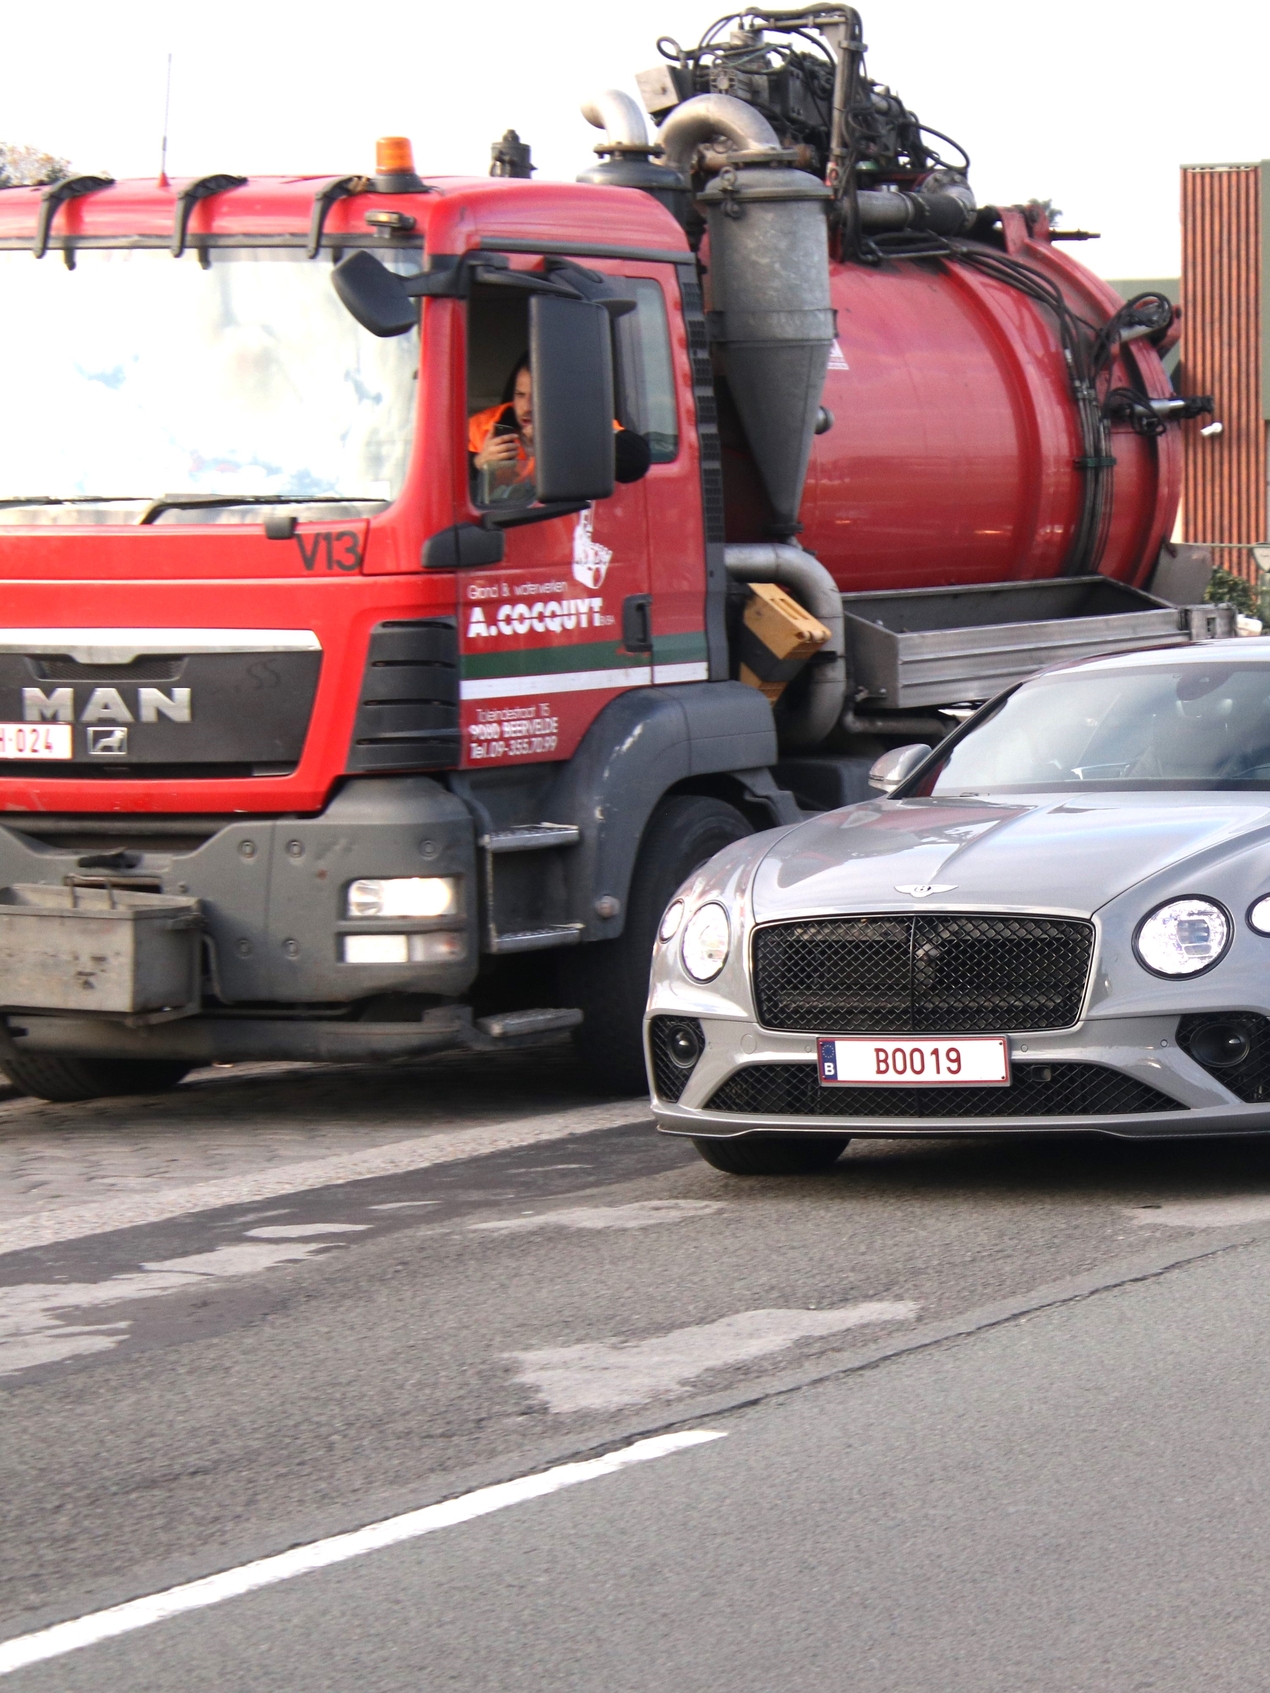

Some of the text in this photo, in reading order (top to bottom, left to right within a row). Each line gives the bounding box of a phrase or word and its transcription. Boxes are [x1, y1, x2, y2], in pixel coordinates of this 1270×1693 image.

[295, 530, 362, 571] V13
[467, 597, 603, 637] A.COCQUYT
[22, 687, 192, 722] MAN
[502, 717, 558, 738] BEERVELDE
[824, 1062, 835, 1076] B
